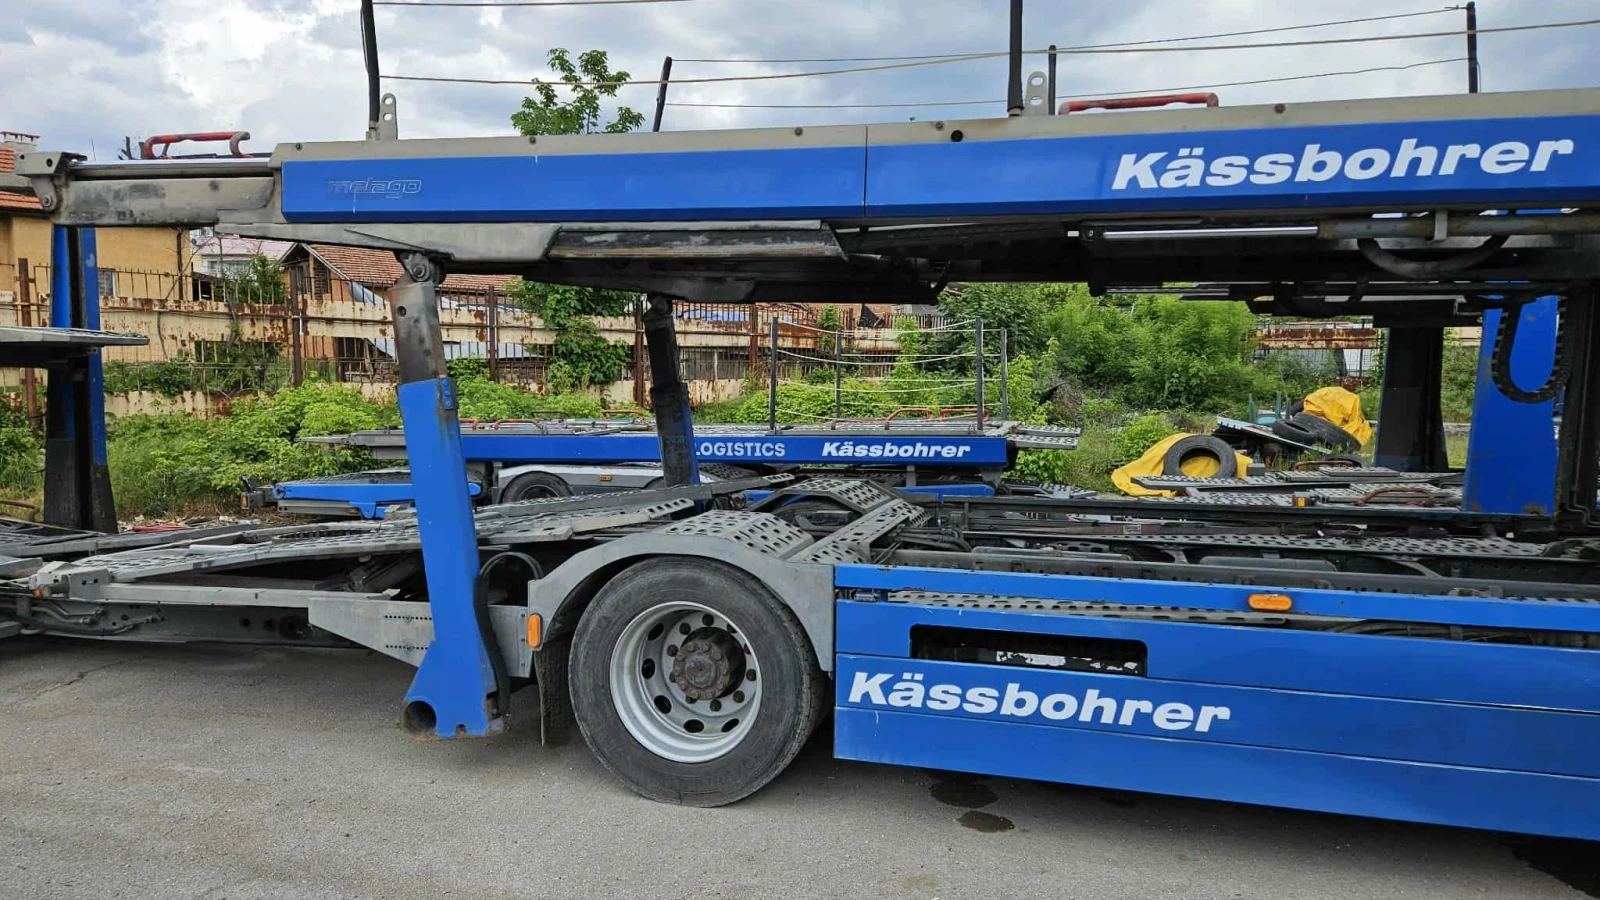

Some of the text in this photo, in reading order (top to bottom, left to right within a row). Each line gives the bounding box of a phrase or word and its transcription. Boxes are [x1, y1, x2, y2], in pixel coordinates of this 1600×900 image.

[1111, 138, 1574, 191] Kässbohrer
[822, 441, 971, 458] Kässbohrer
[848, 671, 1231, 733] Kässbohrer
